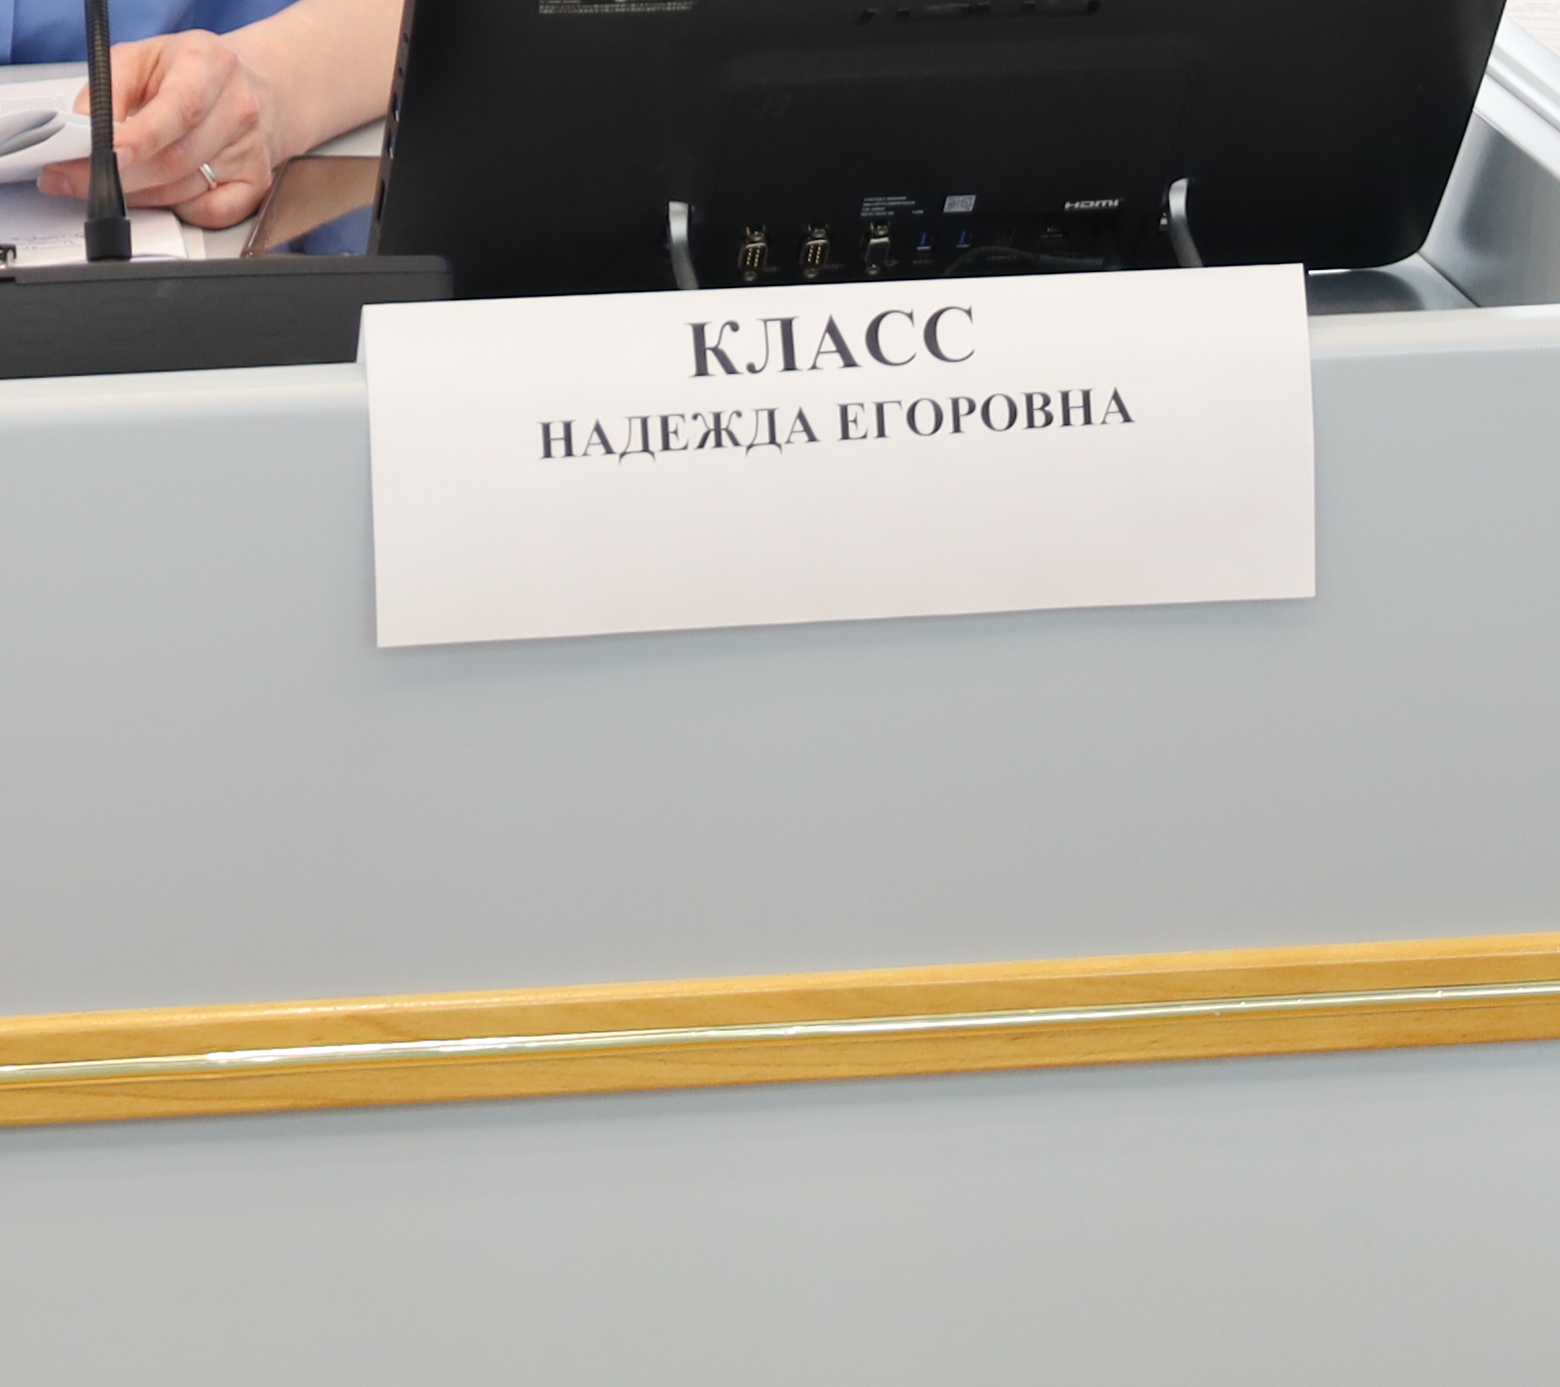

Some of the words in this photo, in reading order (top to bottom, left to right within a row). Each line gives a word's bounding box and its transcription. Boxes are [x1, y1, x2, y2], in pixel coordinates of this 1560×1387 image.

[1063, 198, 1121, 212] HDMI
[689, 305, 976, 379] КЛАСС
[539, 407, 820, 465] НАДЕЖДА
[837, 386, 1136, 442] ЕГОРОВНА
